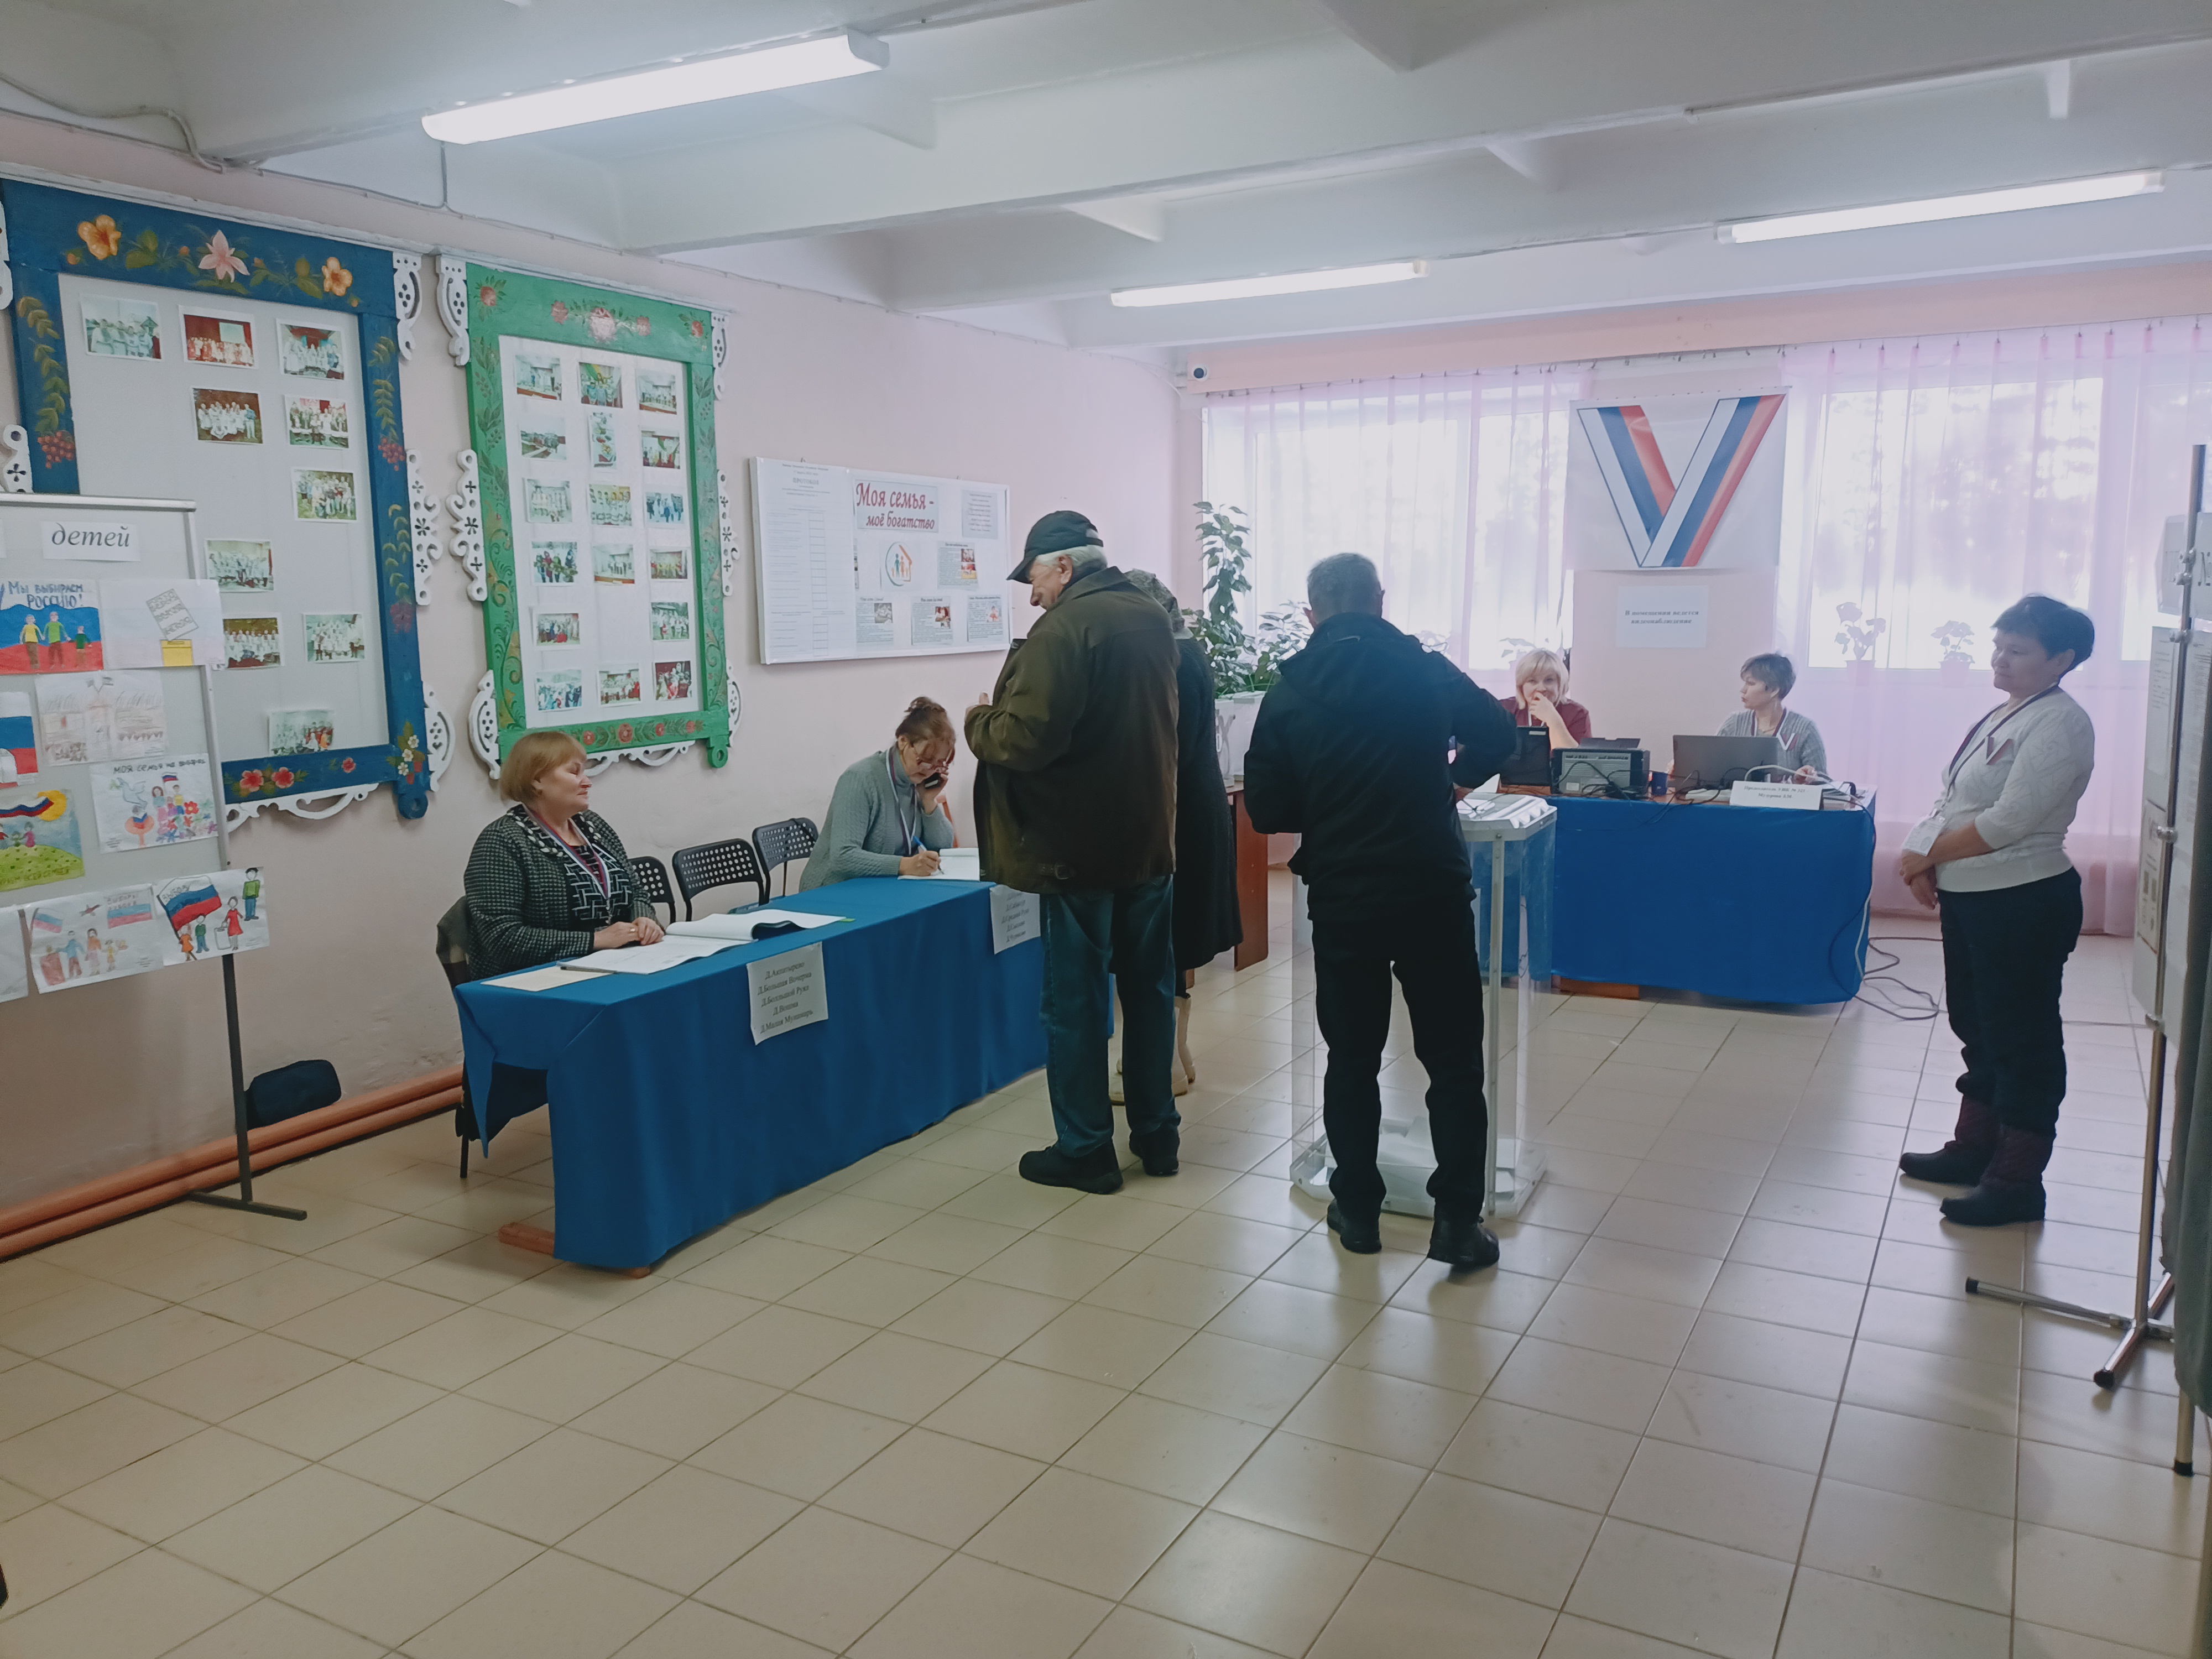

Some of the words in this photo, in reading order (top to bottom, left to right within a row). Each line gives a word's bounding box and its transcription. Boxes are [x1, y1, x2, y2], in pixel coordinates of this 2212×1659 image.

[856, 482, 886, 507] Моя
[890, 491, 926, 510] семья
[866, 513, 885, 526] моё
[886, 510, 935, 529] богатство
[52, 522, 129, 547] детей
